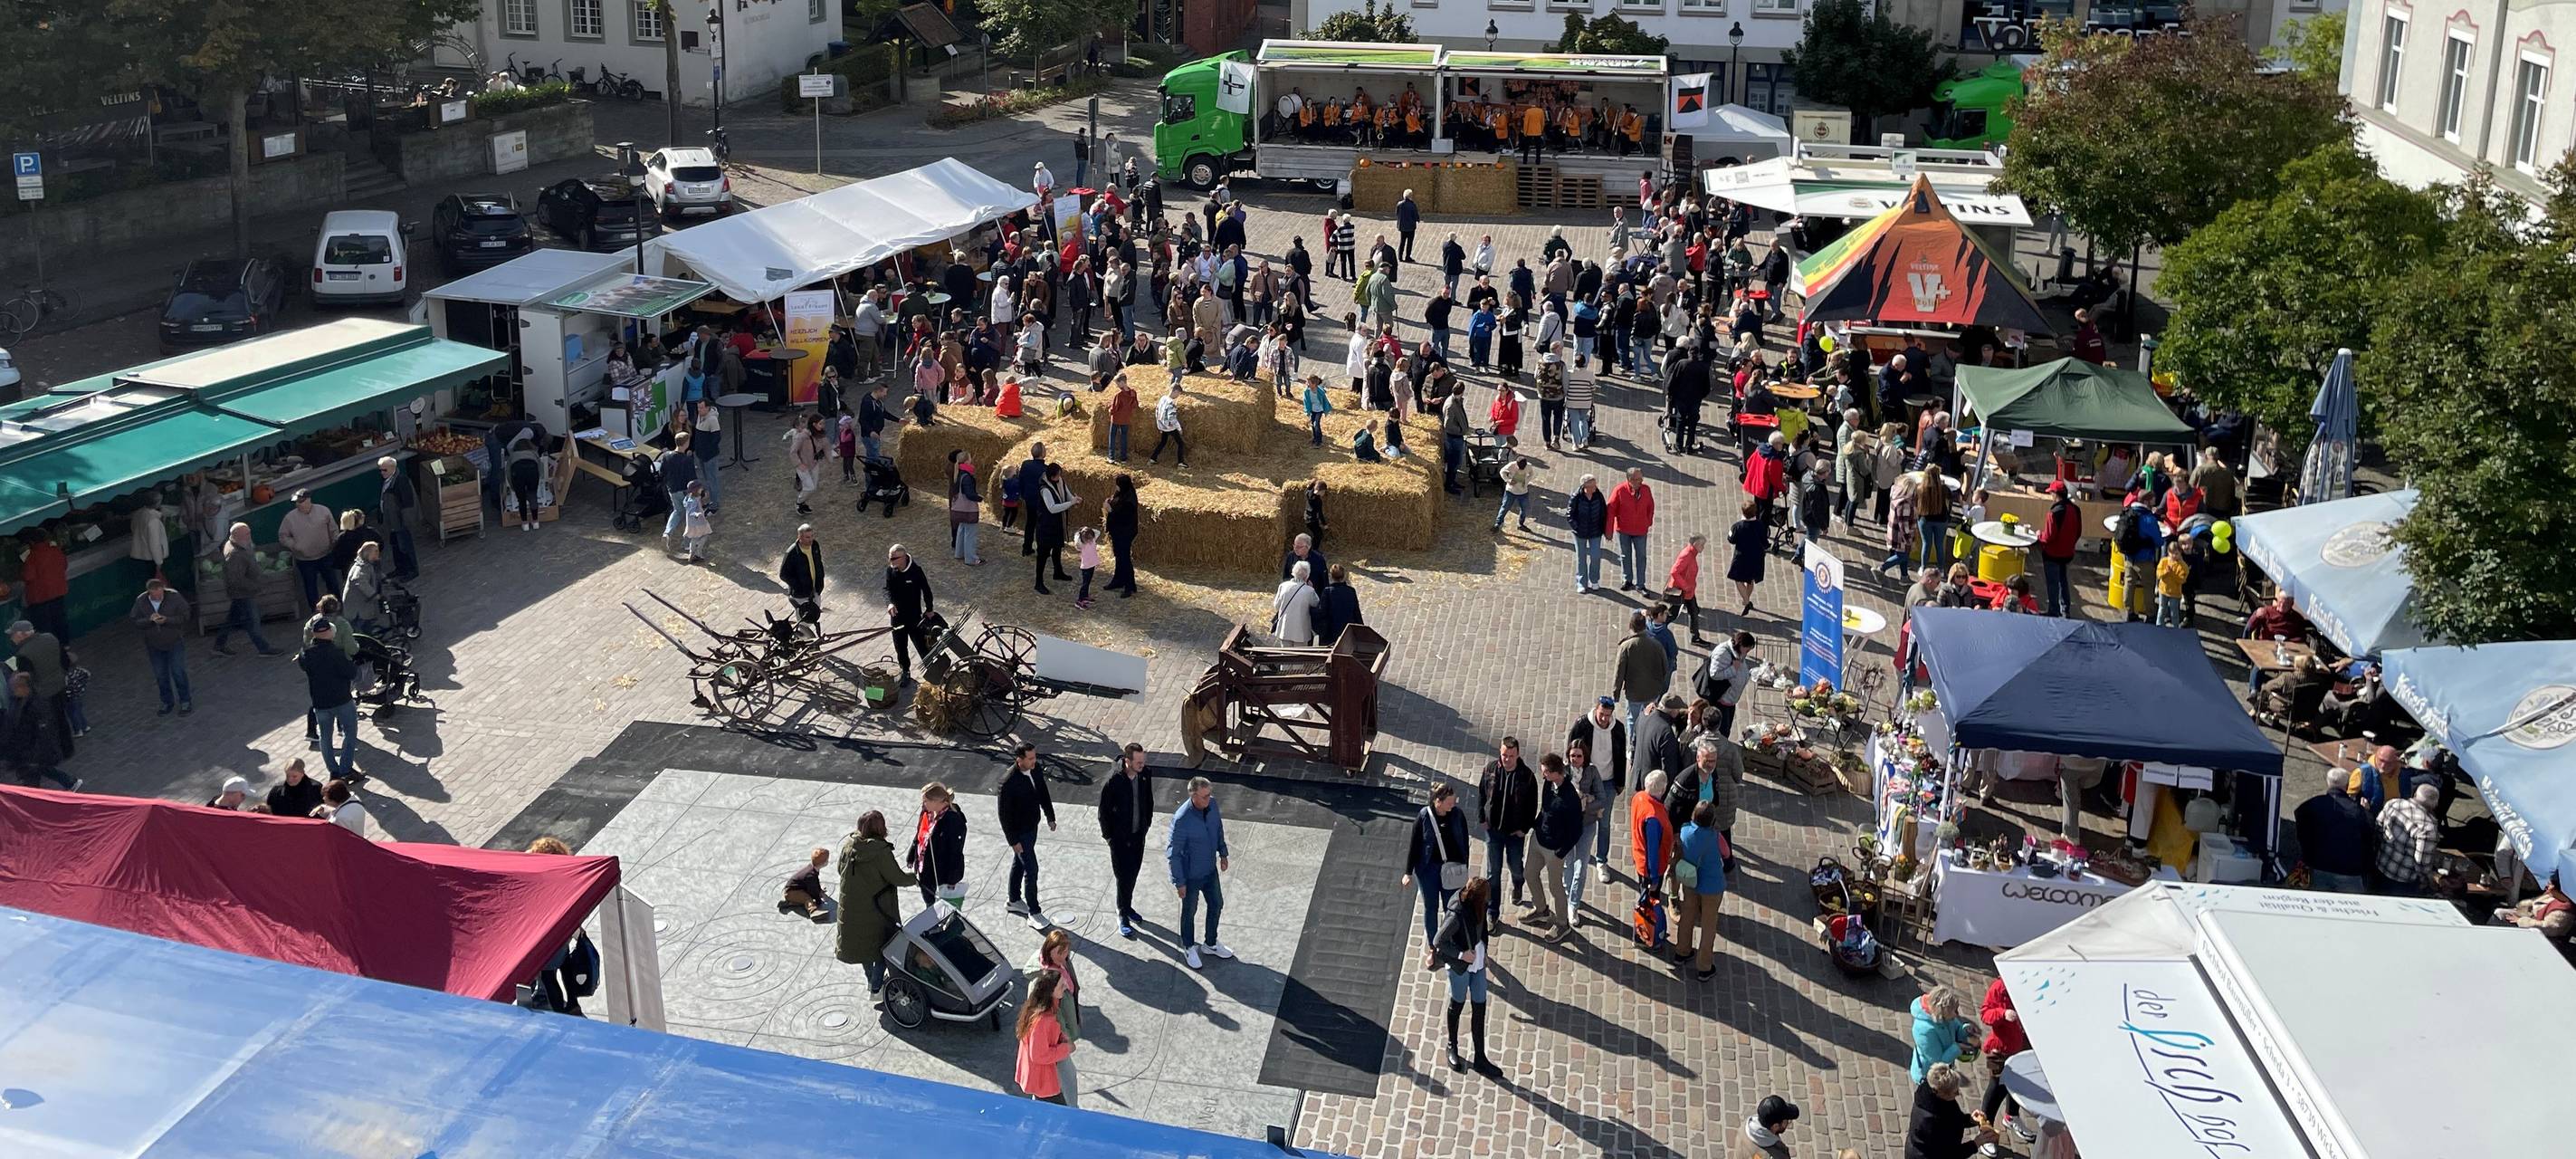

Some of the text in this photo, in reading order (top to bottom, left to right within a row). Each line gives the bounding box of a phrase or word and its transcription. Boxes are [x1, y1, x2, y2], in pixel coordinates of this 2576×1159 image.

[100, 91, 141, 106] VELTINS
[21, 157, 33, 173] P
[2259, 901, 2314, 912] Qualität
[2262, 895, 2310, 905] Region
[2313, 897, 2334, 905] der
[2332, 907, 2380, 916] Frische
[2133, 990, 2176, 1018] der
[2227, 981, 2257, 1032] Baumüller
[2263, 1037, 2285, 1078] Scheda
[2296, 1093, 2316, 1128] 58739
